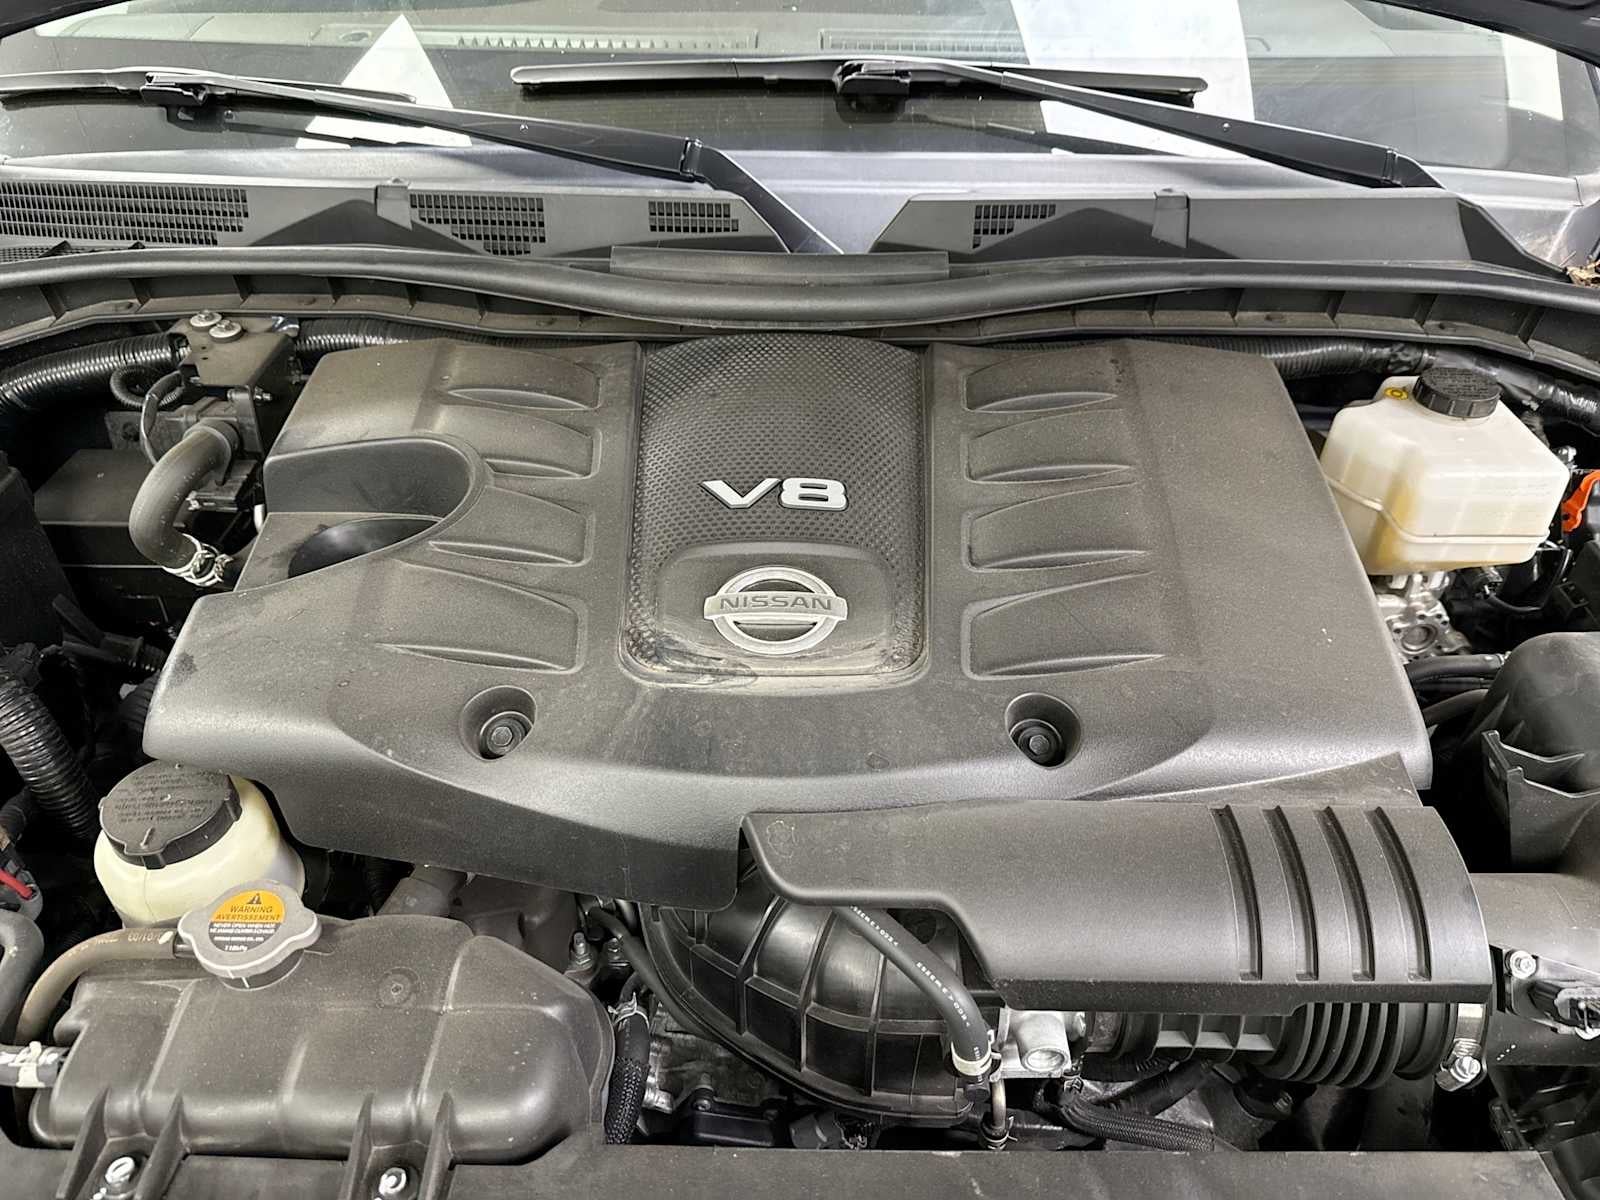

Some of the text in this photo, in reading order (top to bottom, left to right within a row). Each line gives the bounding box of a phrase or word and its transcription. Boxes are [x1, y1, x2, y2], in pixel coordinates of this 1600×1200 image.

[700, 477, 849, 511] V8
[719, 596, 832, 611] NISSAN
[230, 905, 273, 913] WARNING
